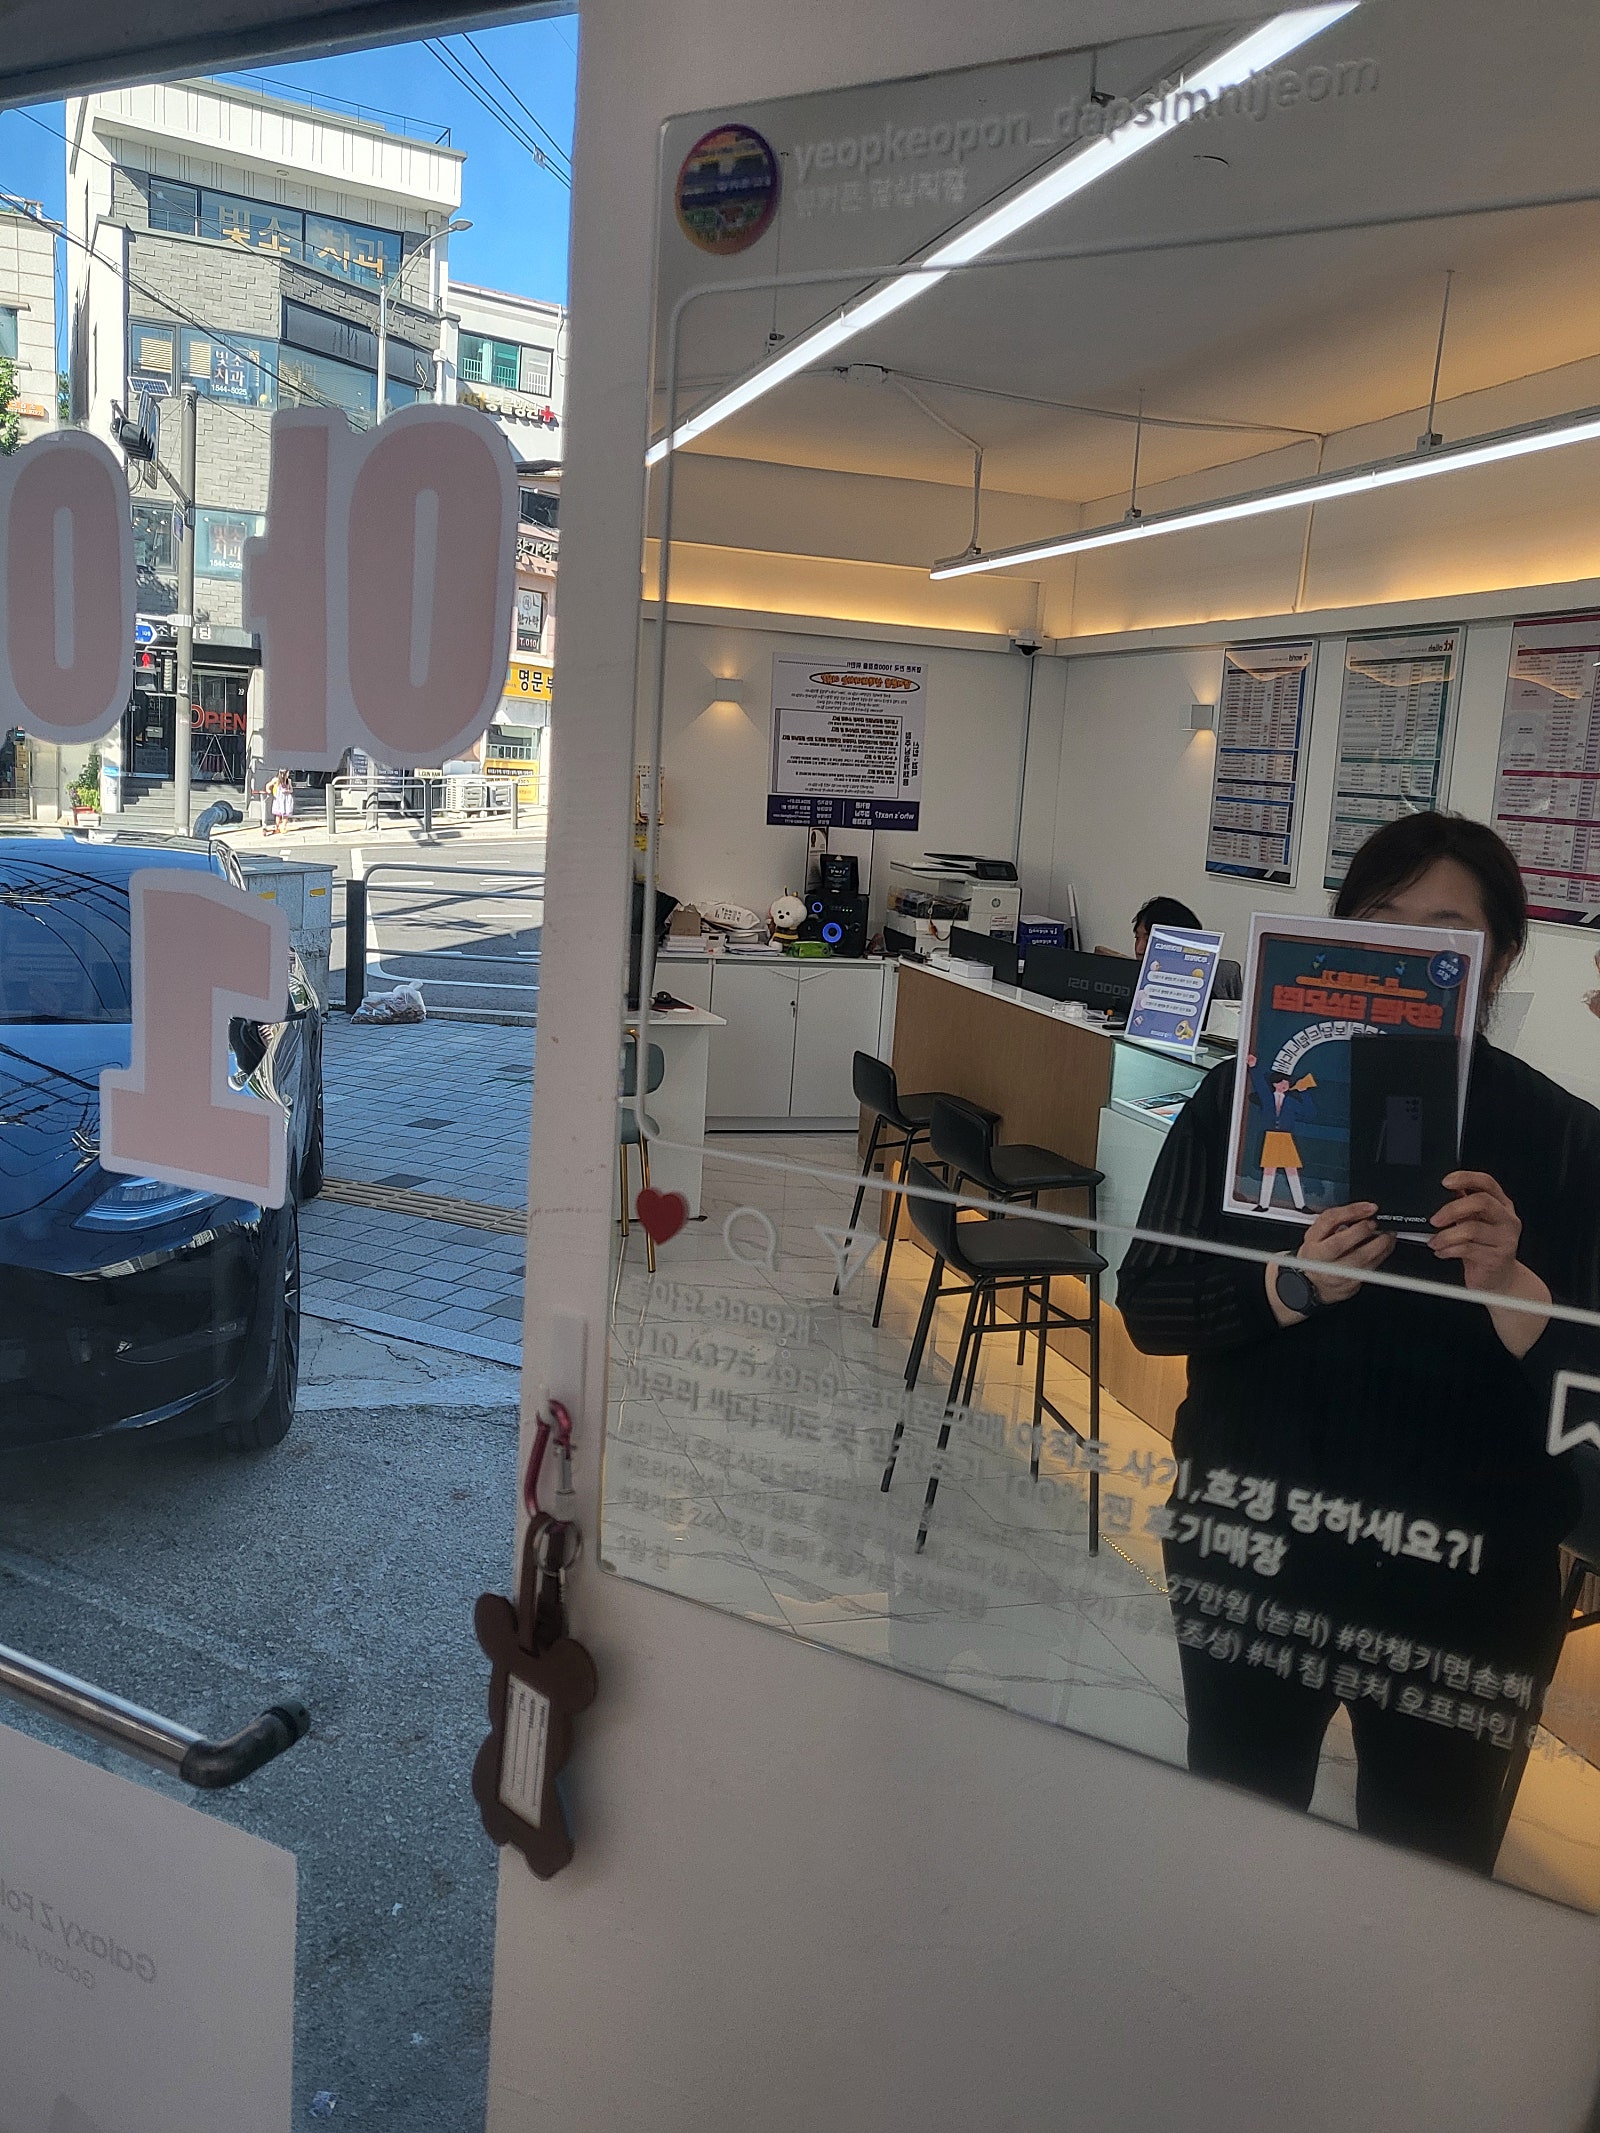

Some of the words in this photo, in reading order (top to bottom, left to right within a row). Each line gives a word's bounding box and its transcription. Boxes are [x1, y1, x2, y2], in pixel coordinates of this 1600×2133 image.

[317, 229, 388, 278] 치과
[214, 350, 246, 368] 빛소
[214, 368, 246, 387] 치과
[211, 383, 248, 396] 1544-5025
